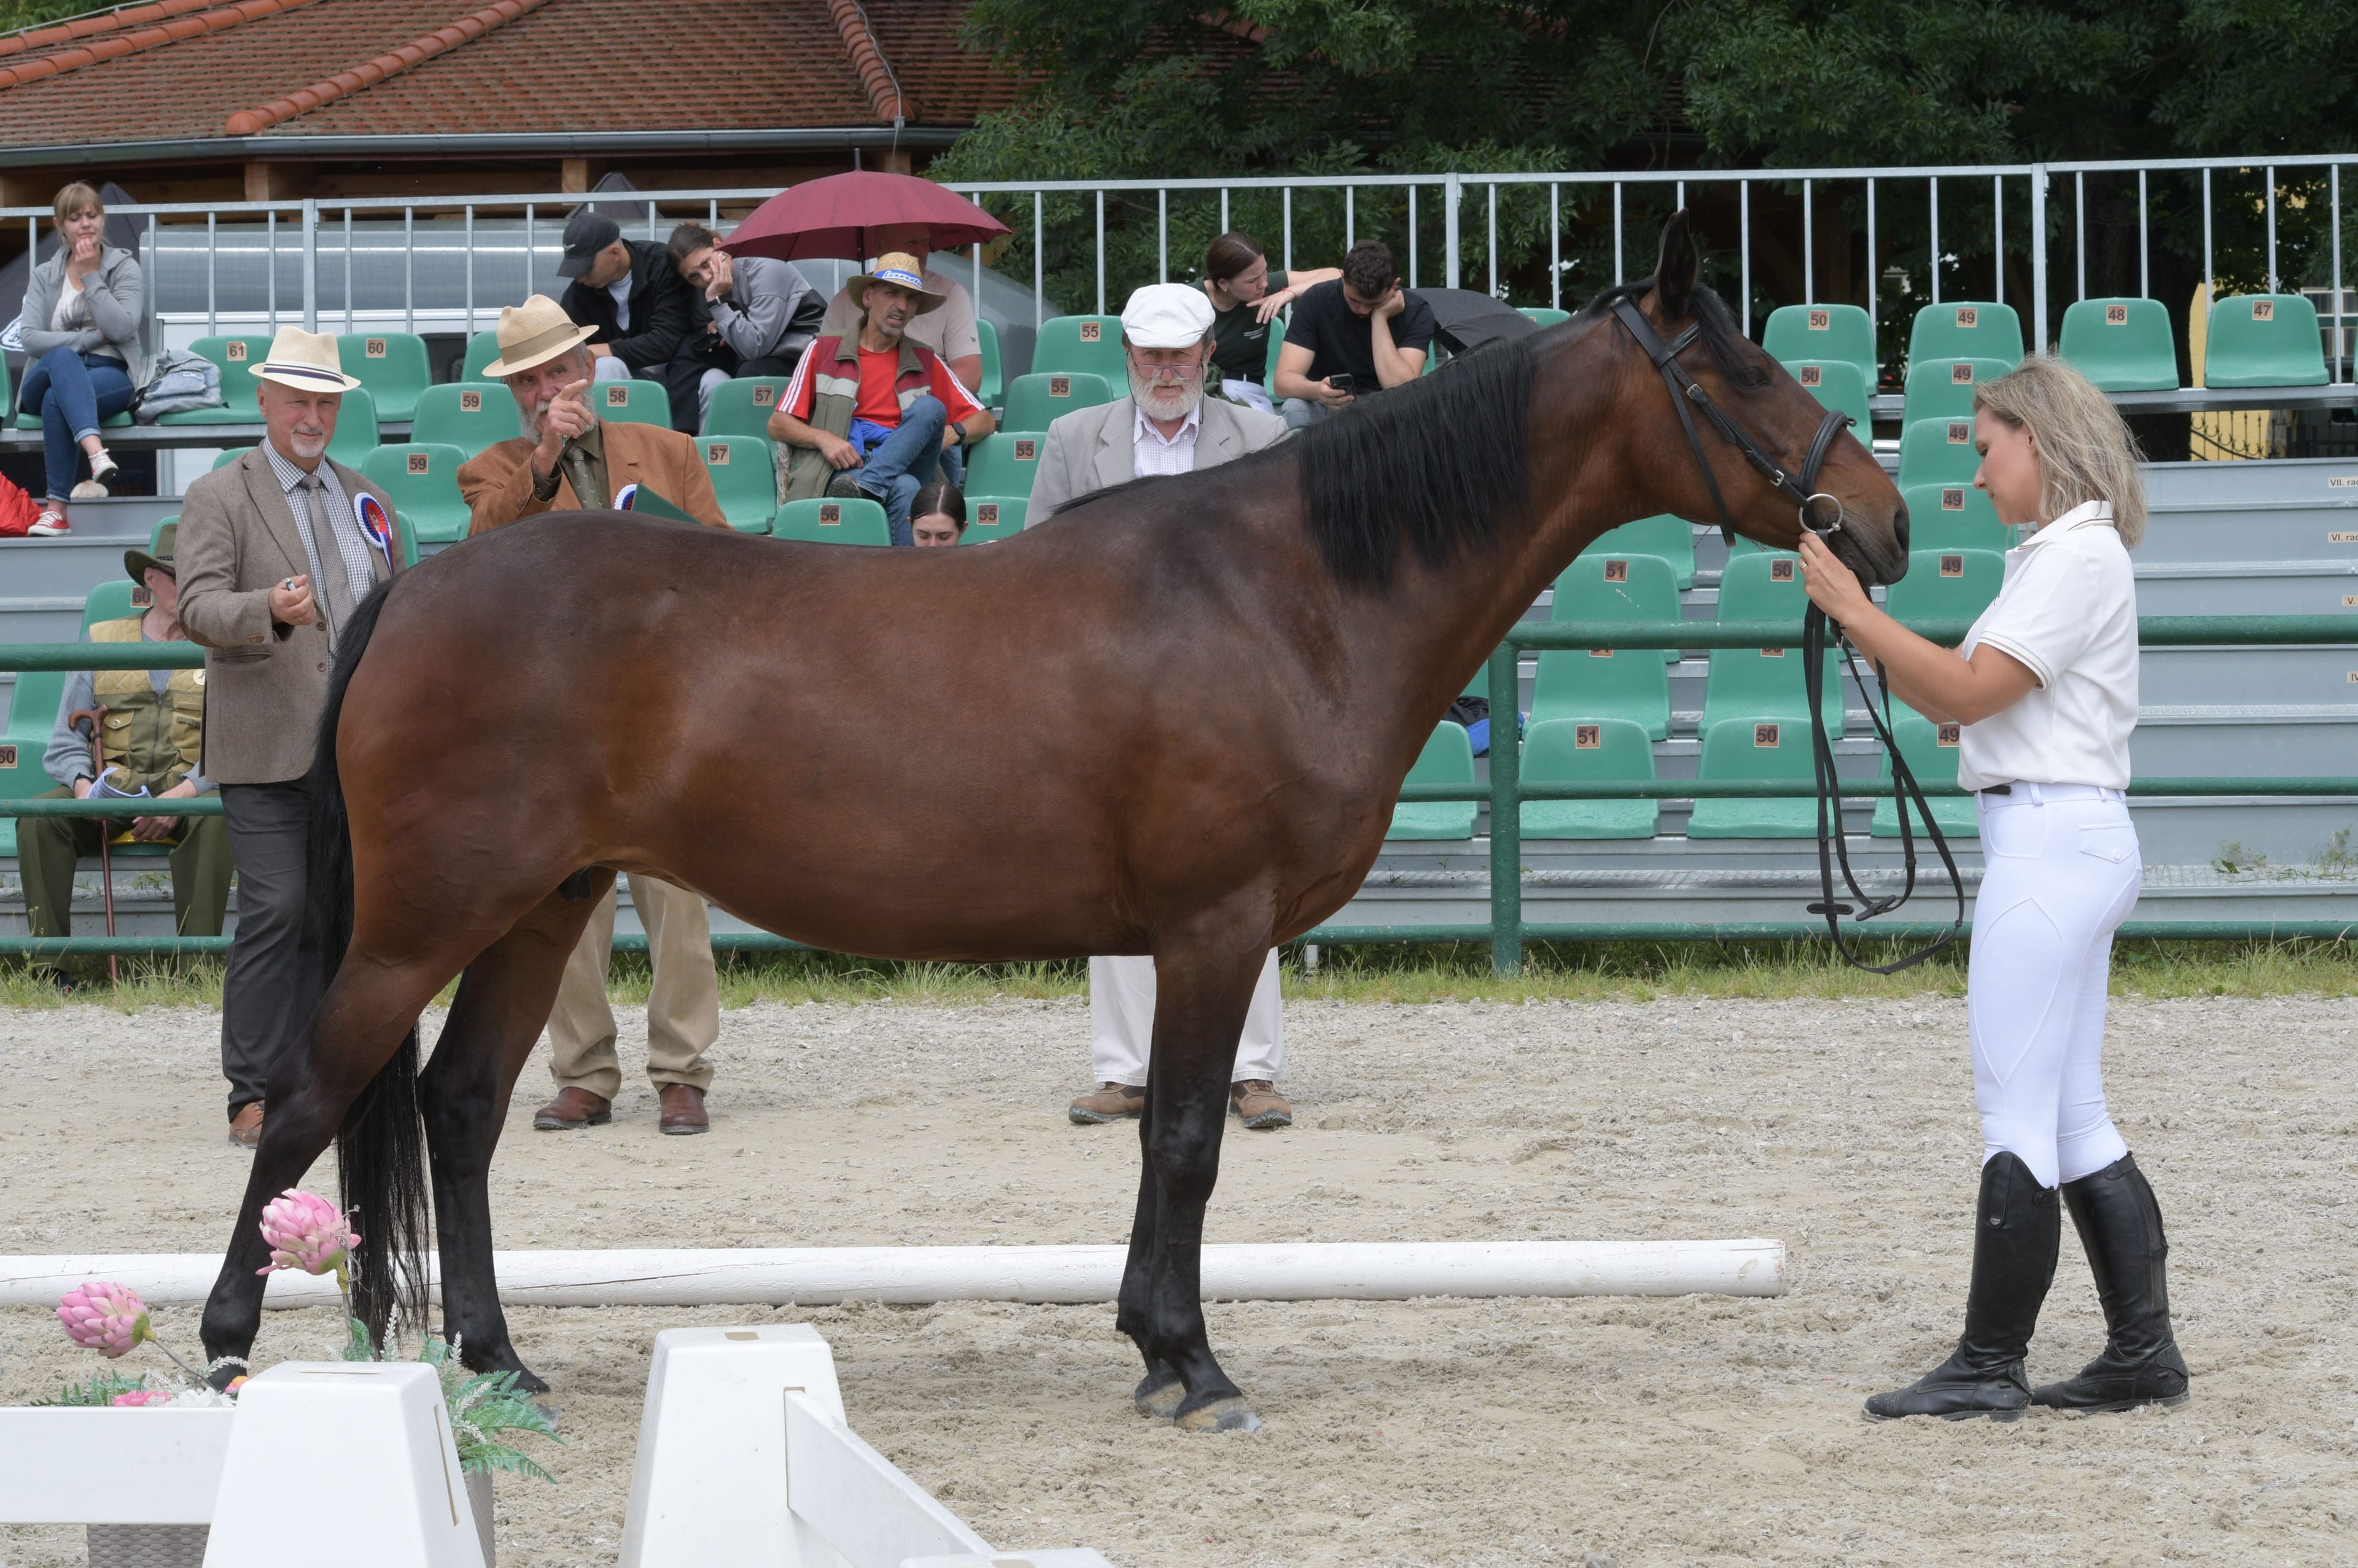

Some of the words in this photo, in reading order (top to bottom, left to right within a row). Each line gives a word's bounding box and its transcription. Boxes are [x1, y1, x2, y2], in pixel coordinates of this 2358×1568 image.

[2107, 309, 2125, 321] 48
[2254, 305, 2271, 317] 47
[1811, 314, 1827, 327] 50
[1958, 312, 1975, 324] 49
[1082, 325, 1099, 338] 55
[230, 345, 244, 357] 61
[368, 342, 384, 354] 60
[1802, 370, 1819, 383] 50
[1953, 368, 1971, 381] 49
[1051, 381, 1068, 394] 55
[462, 395, 479, 408] 59
[609, 390, 626, 403] 58
[755, 389, 772, 402] 57
[1949, 427, 1967, 440] 49
[710, 448, 727, 461] 57
[1016, 444, 1033, 457] 55
[410, 457, 427, 470] 59
[1944, 494, 1962, 506] 49
[821, 508, 839, 521] 56
[979, 508, 997, 521] 55
[1606, 564, 1624, 578] 51
[1773, 564, 1792, 578] 50
[1942, 559, 1961, 573] 49
[133, 591, 150, 604] 60
[2347, 597, 2356, 605] V.
[1578, 729, 1596, 744] 51
[1757, 728, 1777, 743] 50
[1939, 728, 1958, 742] 49
[0, 750, 15, 764] 60
